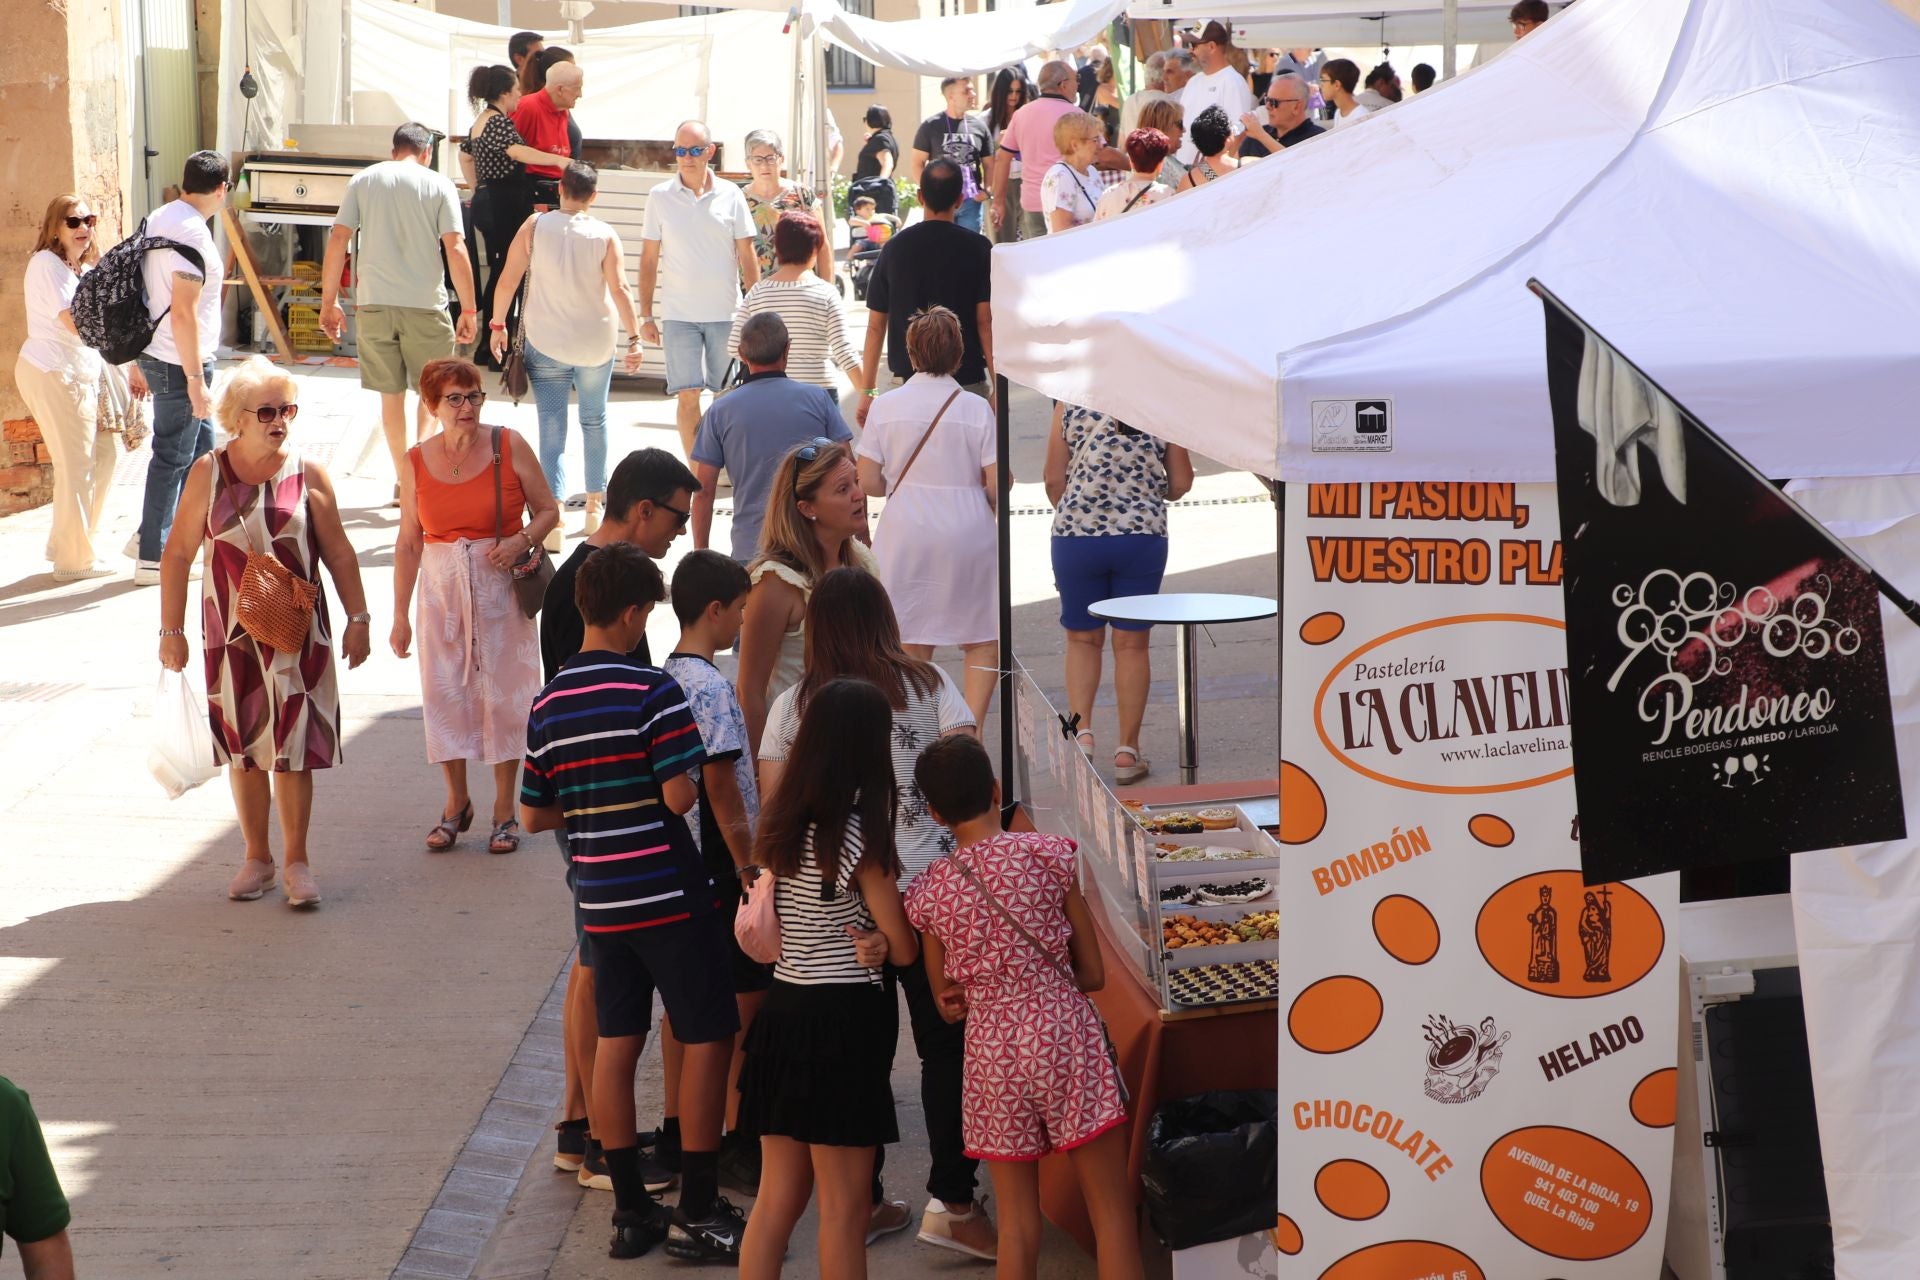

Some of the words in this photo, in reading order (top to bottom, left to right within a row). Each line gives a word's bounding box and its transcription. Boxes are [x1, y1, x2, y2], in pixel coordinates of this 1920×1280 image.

[1367, 434, 1388, 445] MARKET
[1308, 483, 1361, 518] MI
[1306, 536, 1491, 585] VUESTRO
[1354, 655, 1446, 682] Pastelería
[1338, 687, 1403, 756] LA
[1638, 672, 1836, 745] Pendoneo
[1440, 736, 1574, 763] www.laclavelina.
[1642, 748, 1683, 763] RENCLE
[1684, 739, 1733, 756] BODEGAS
[1740, 731, 1787, 747] ARNEDO
[1311, 825, 1431, 896] BOMBÓN
[1538, 1015, 1645, 1082] HELADO
[1293, 1099, 1454, 1183] CHOCOLATE
[1507, 1146, 1555, 1175] AVENIDA
[1556, 1167, 1573, 1183] DE
[1572, 1175, 1587, 1191] LA
[1588, 1182, 1621, 1207] RIOJA,
[1625, 1199, 1640, 1213] 19
[1534, 1177, 1555, 1194] 941
[1557, 1187, 1578, 1205] 403
[1579, 1197, 1600, 1214] 100
[1523, 1191, 1550, 1212] QUEL
[1552, 1204, 1566, 1219] La
[1567, 1210, 1596, 1231] Rioja
